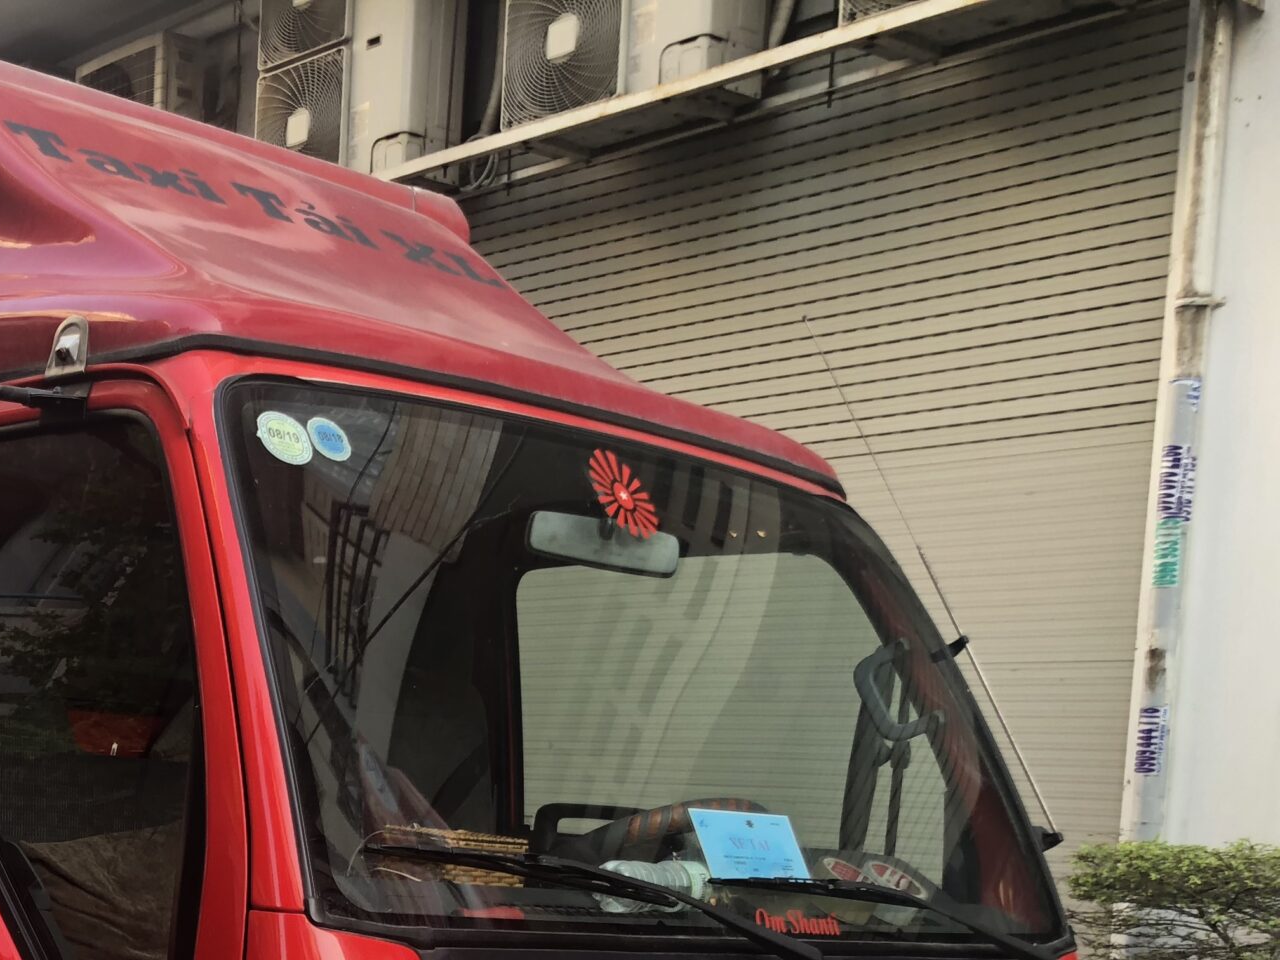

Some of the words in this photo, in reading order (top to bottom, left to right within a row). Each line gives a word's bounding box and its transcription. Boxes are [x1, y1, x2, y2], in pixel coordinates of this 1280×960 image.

[3, 120, 226, 207] Taxi
[230, 181, 380, 250] Tải
[381, 228, 509, 290] XL
[268, 427, 300, 444] 08/19
[786, 908, 842, 936] Shanti
